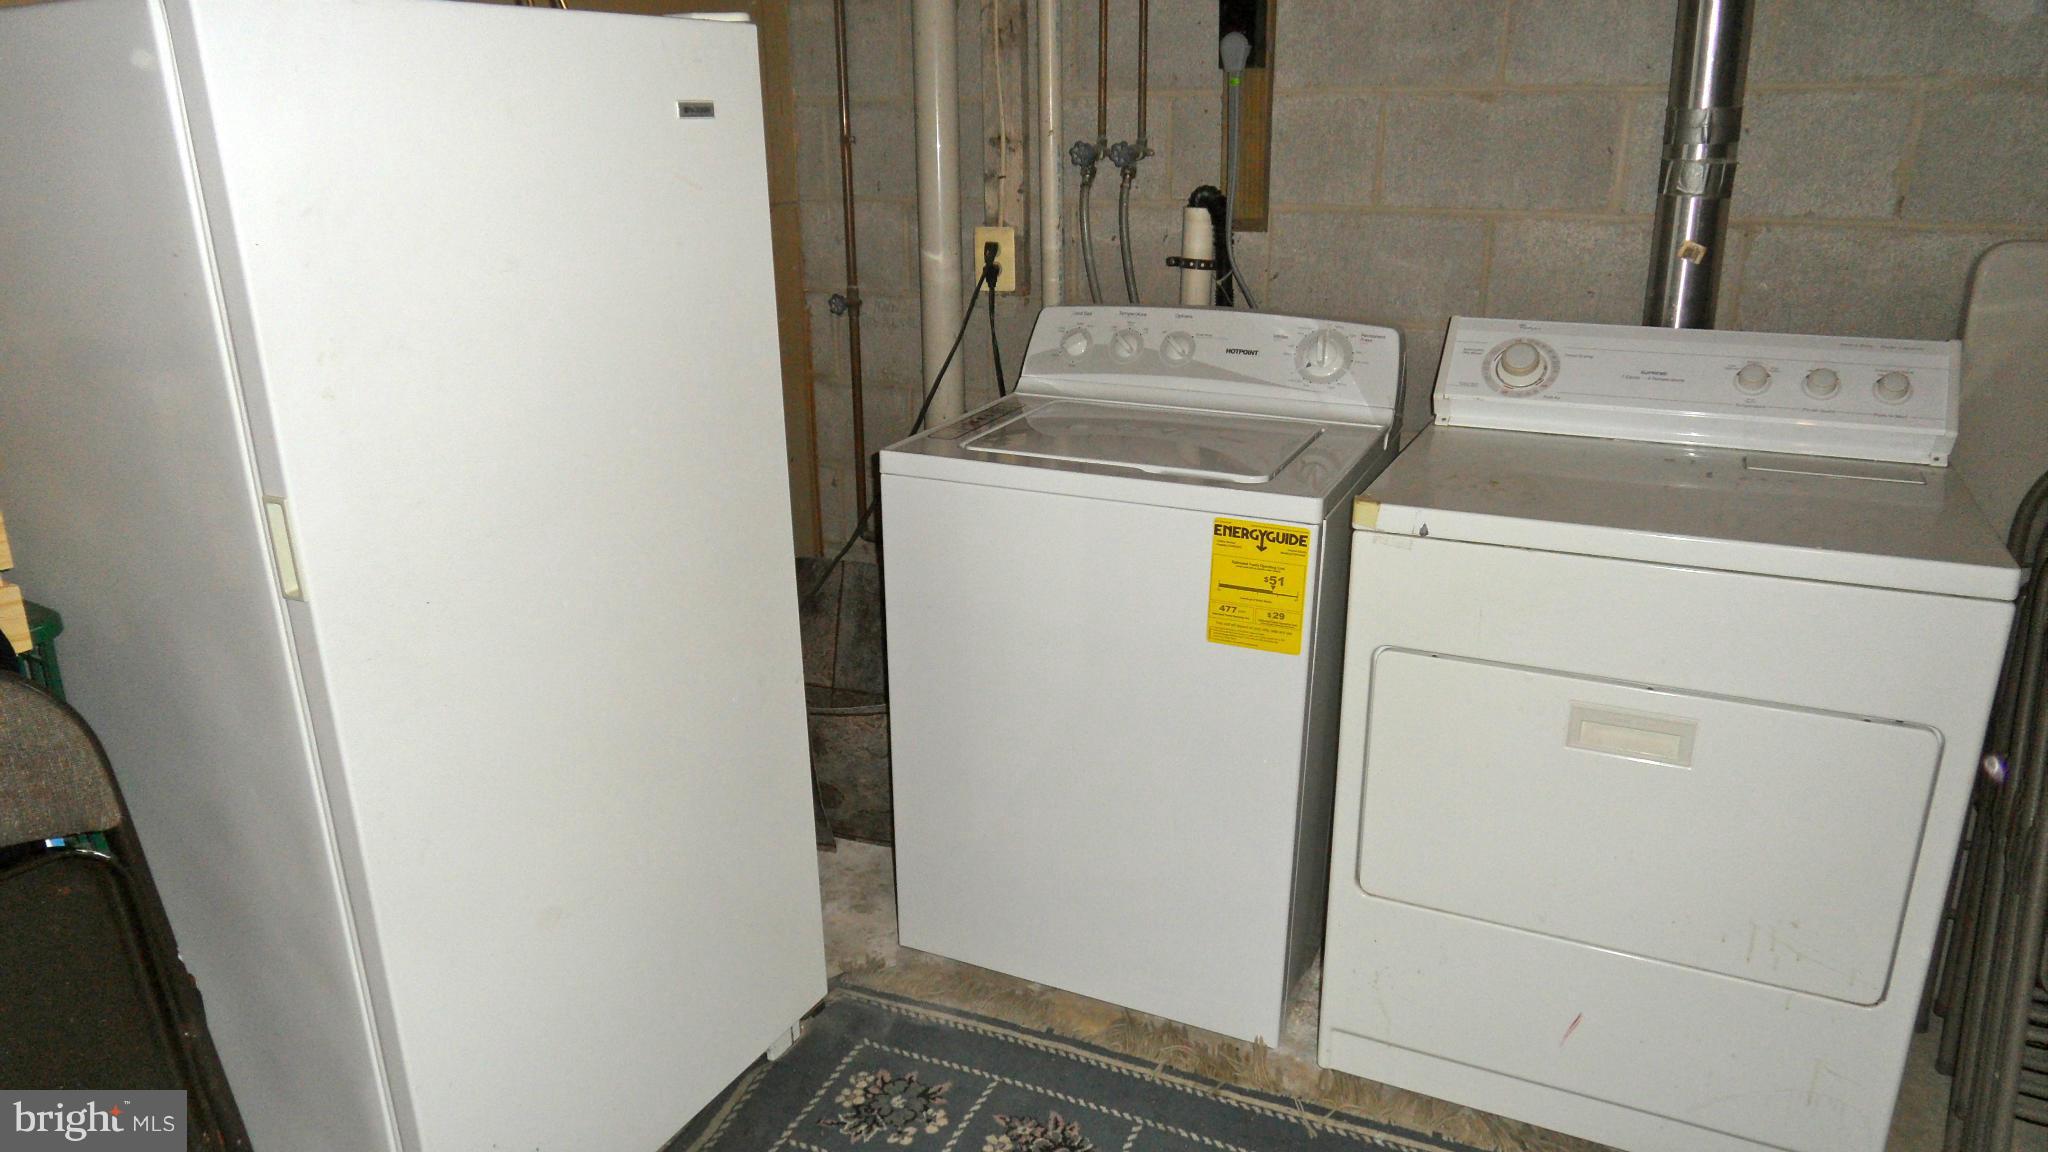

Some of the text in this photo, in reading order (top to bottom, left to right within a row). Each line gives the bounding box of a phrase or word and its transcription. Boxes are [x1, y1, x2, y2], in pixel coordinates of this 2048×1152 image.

[1225, 347, 1259, 356] HOTPOINT
[1214, 524, 1308, 548] ENERGYGUIDE
[1263, 575, 1285, 587] $51
[1219, 605, 1237, 613] 477
